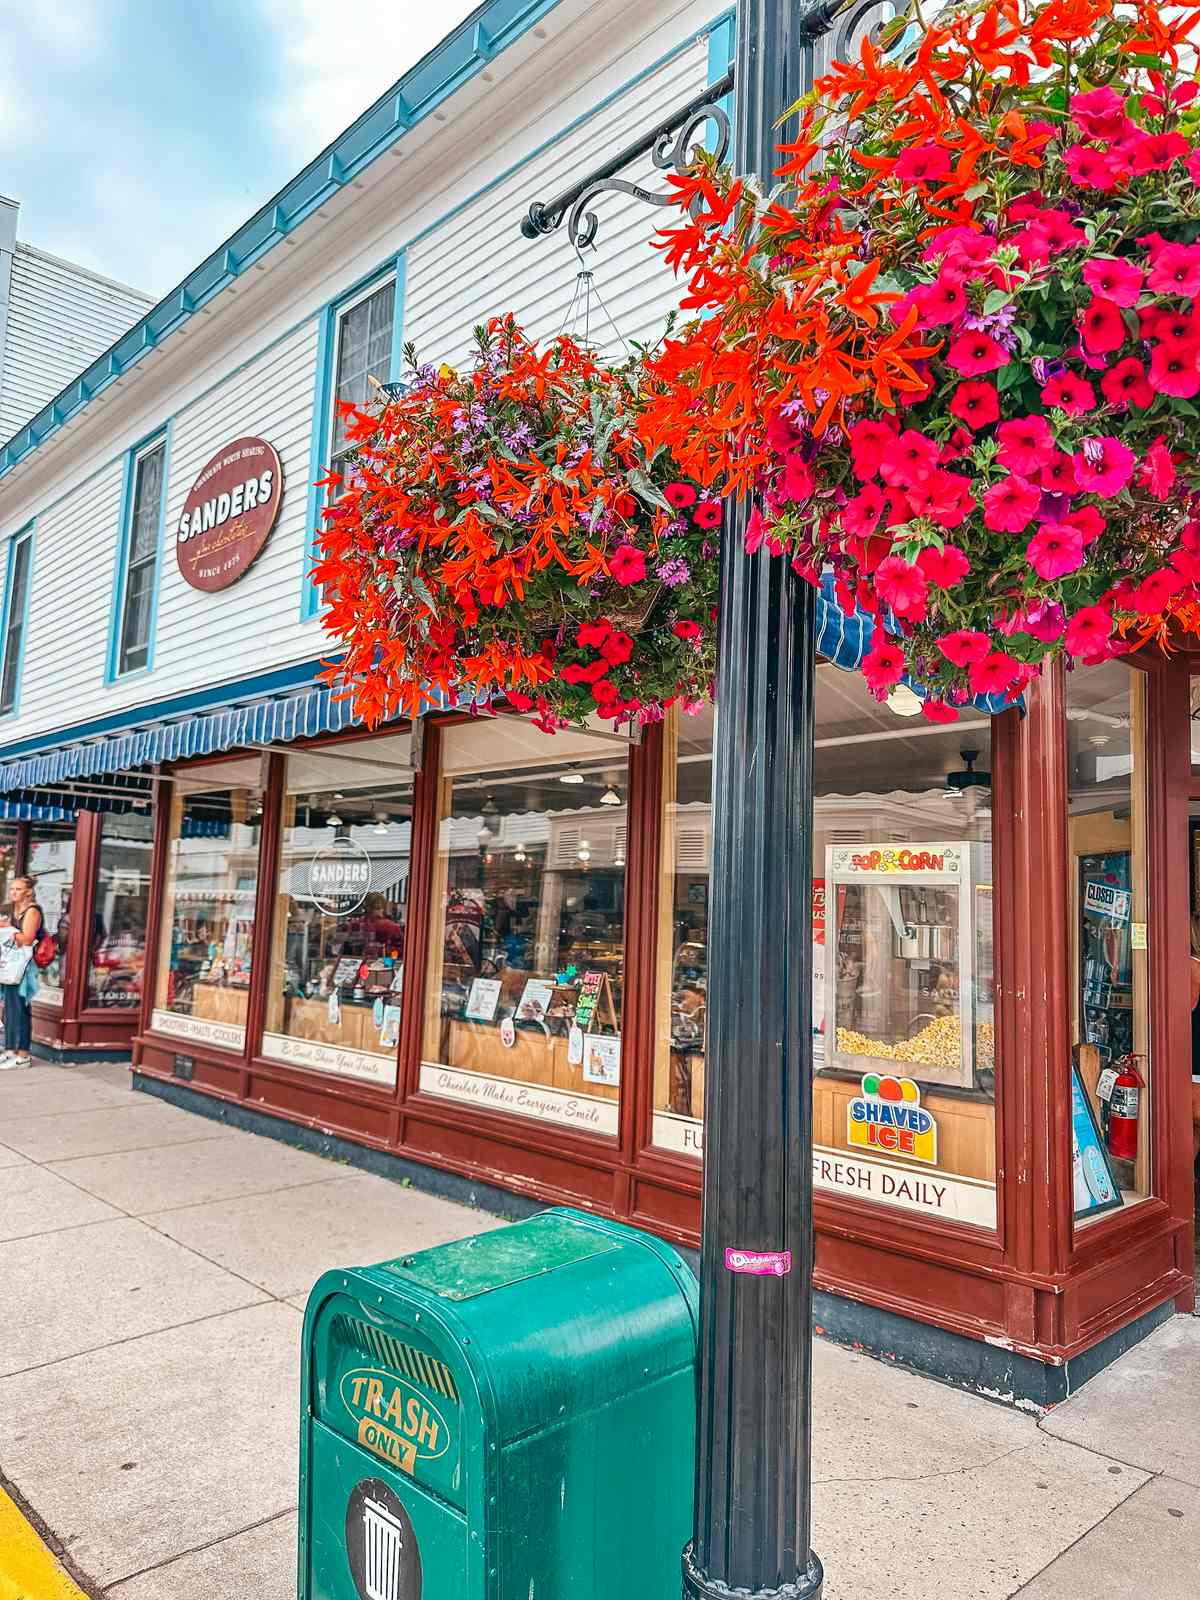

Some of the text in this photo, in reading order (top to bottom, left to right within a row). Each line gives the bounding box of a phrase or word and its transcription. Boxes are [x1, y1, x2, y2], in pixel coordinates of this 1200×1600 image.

[178, 470, 273, 543] SANDERS
[312, 863, 368, 882] SANDERS
[852, 850, 944, 870] POP CORN
[1087, 884, 1114, 905] CLOSED
[438, 1073, 600, 1123] Chocolate Makes Everyone Smile
[852, 1100, 931, 1133] SHAVED
[867, 1122, 915, 1153] ICE
[812, 1158, 872, 1191] FRESH
[882, 1174, 946, 1207] DAILY
[352, 1377, 439, 1451] TRASH
[365, 1424, 410, 1462] ONLY
